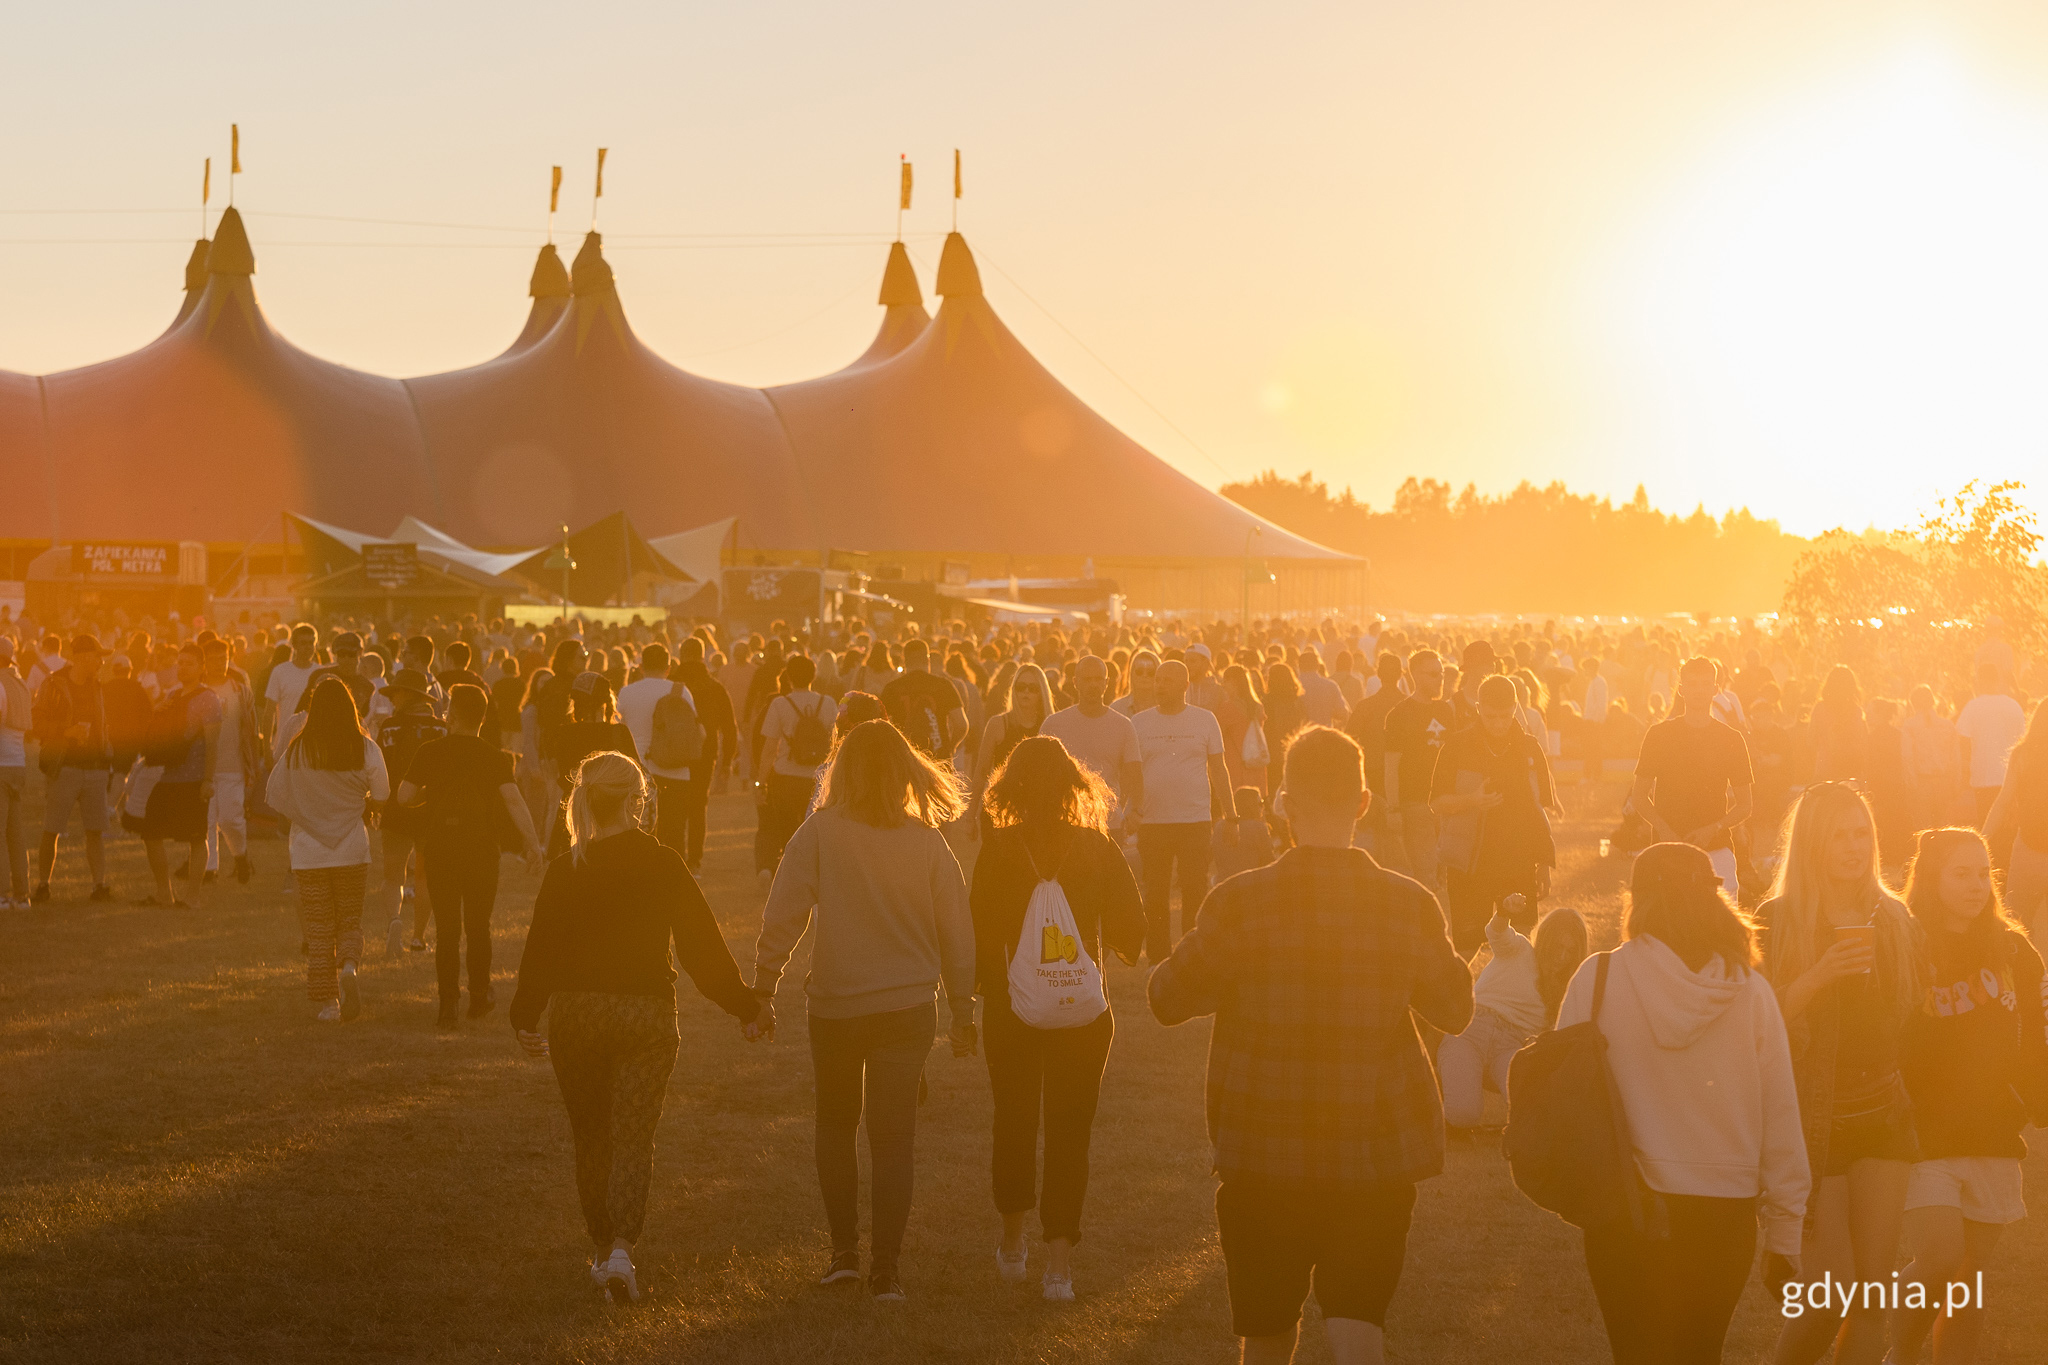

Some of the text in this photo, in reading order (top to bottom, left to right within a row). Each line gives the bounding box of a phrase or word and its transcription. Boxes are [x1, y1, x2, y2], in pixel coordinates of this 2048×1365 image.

[84, 545, 167, 561] ZAPIEKANKA
[122, 560, 162, 573] METRA
[1036, 968, 1058, 979] TAKE
[1059, 970, 1073, 978] THE
[1048, 978, 1083, 988] TO SMILE
